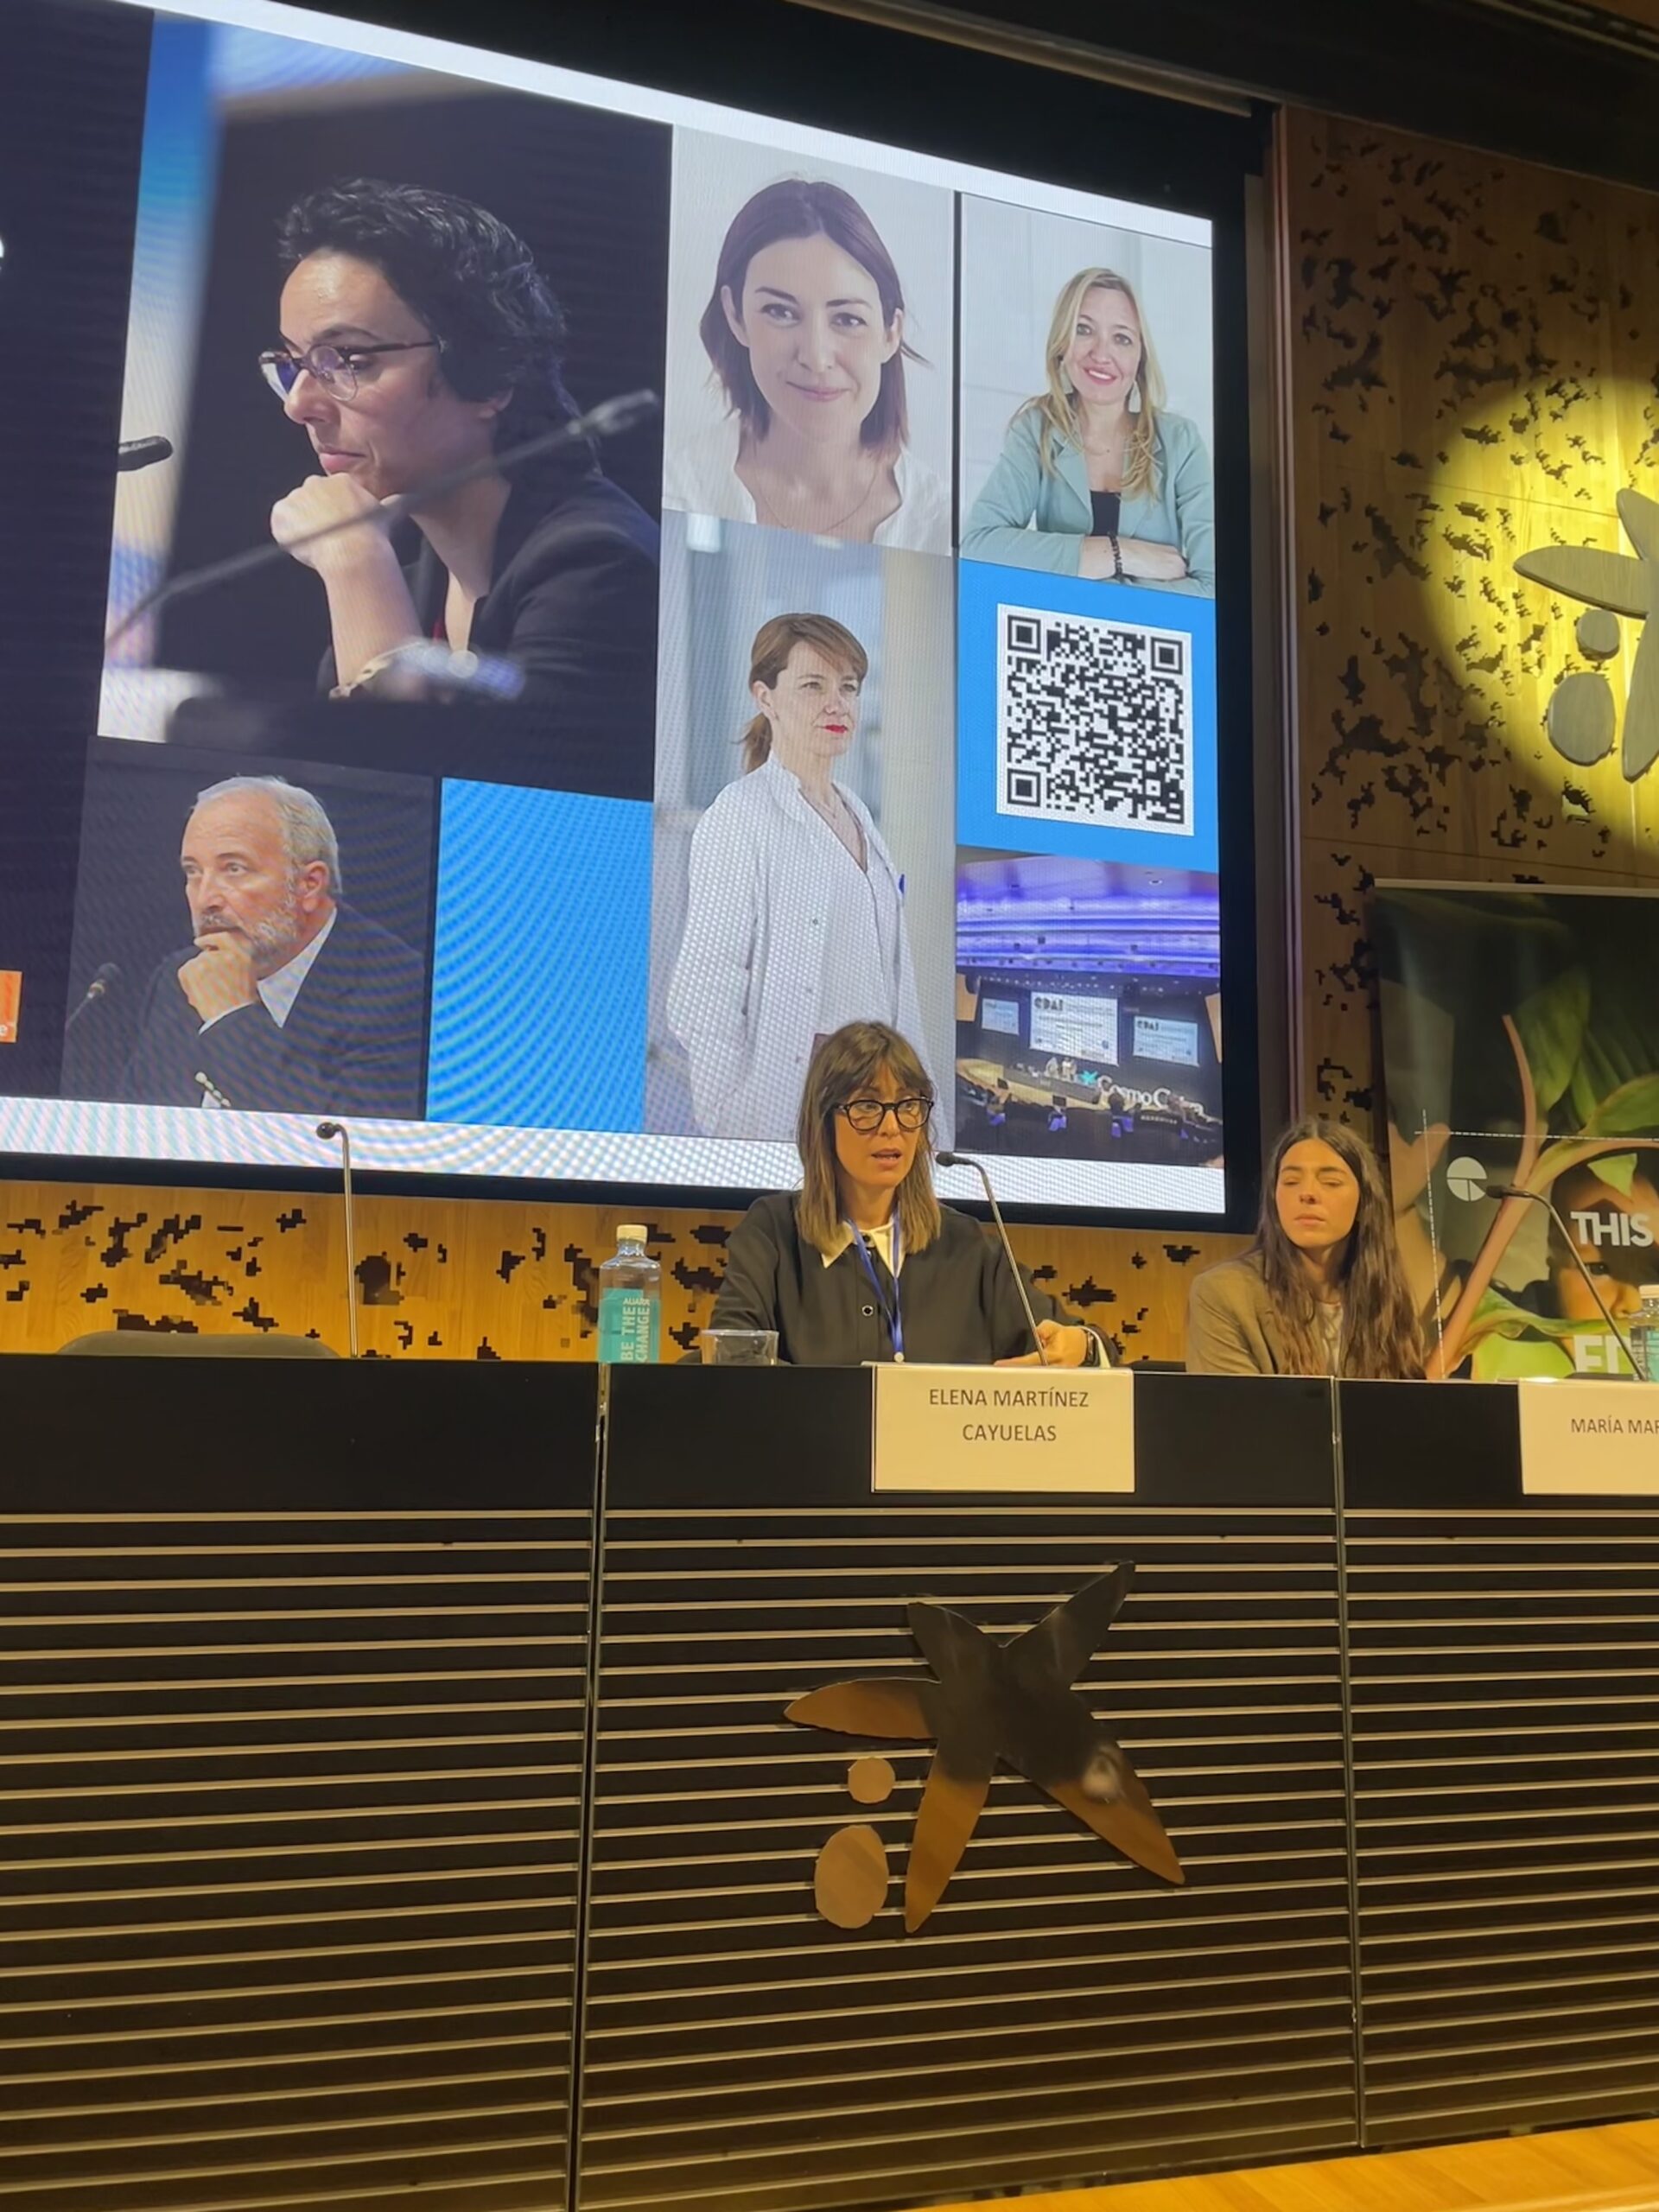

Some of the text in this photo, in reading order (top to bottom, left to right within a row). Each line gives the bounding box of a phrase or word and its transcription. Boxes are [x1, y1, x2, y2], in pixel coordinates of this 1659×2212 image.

[1570, 1211, 1655, 1247] THIS
[620, 1306, 636, 1362] BE THE
[635, 1306, 651, 1363] CHANGE
[929, 1387, 1090, 1408] ELENA MARTÍNEZ
[962, 1423, 1057, 1442] CAYUELAS
[1571, 1414, 1624, 1433] MARÍA
